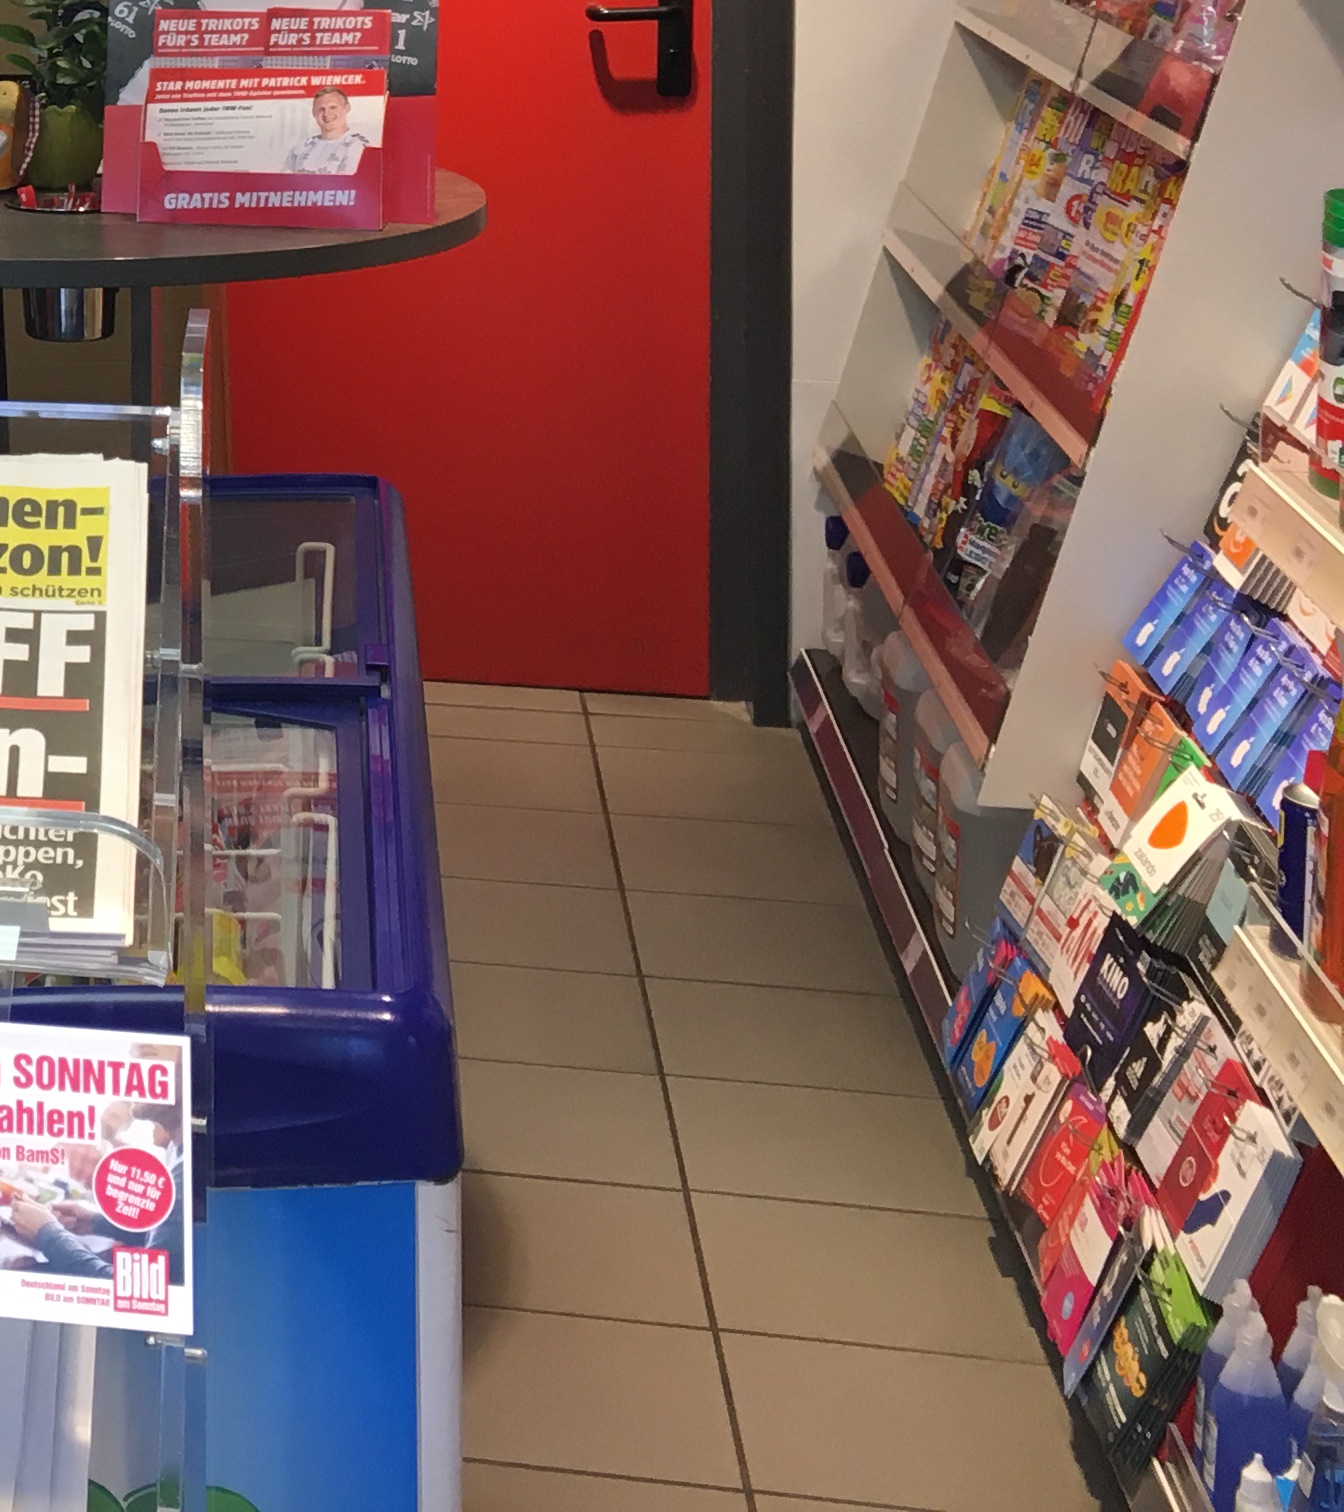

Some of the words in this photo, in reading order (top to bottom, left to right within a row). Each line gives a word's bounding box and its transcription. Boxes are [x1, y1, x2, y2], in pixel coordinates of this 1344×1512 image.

[113, 2, 138, 25] 61
[158, 19, 196, 32] NEUE
[200, 18, 260, 31] TRIKOTS
[203, 33, 249, 46] TEAM?
[155, 81, 182, 92] STAR
[184, 79, 238, 91] MOMENTE
[239, 78, 260, 88] MIT
[261, 76, 308, 88] PATRICK
[164, 193, 230, 209] GRATIS
[234, 190, 356, 208] MITNEHMEN!
[8, 582, 103, 600] schützen
[1101, 953, 1129, 1000] KINO
[13, 1053, 169, 1101] SONNTAG
[15, 1145, 66, 1166] BamS!
[116, 1251, 165, 1301] Bild
